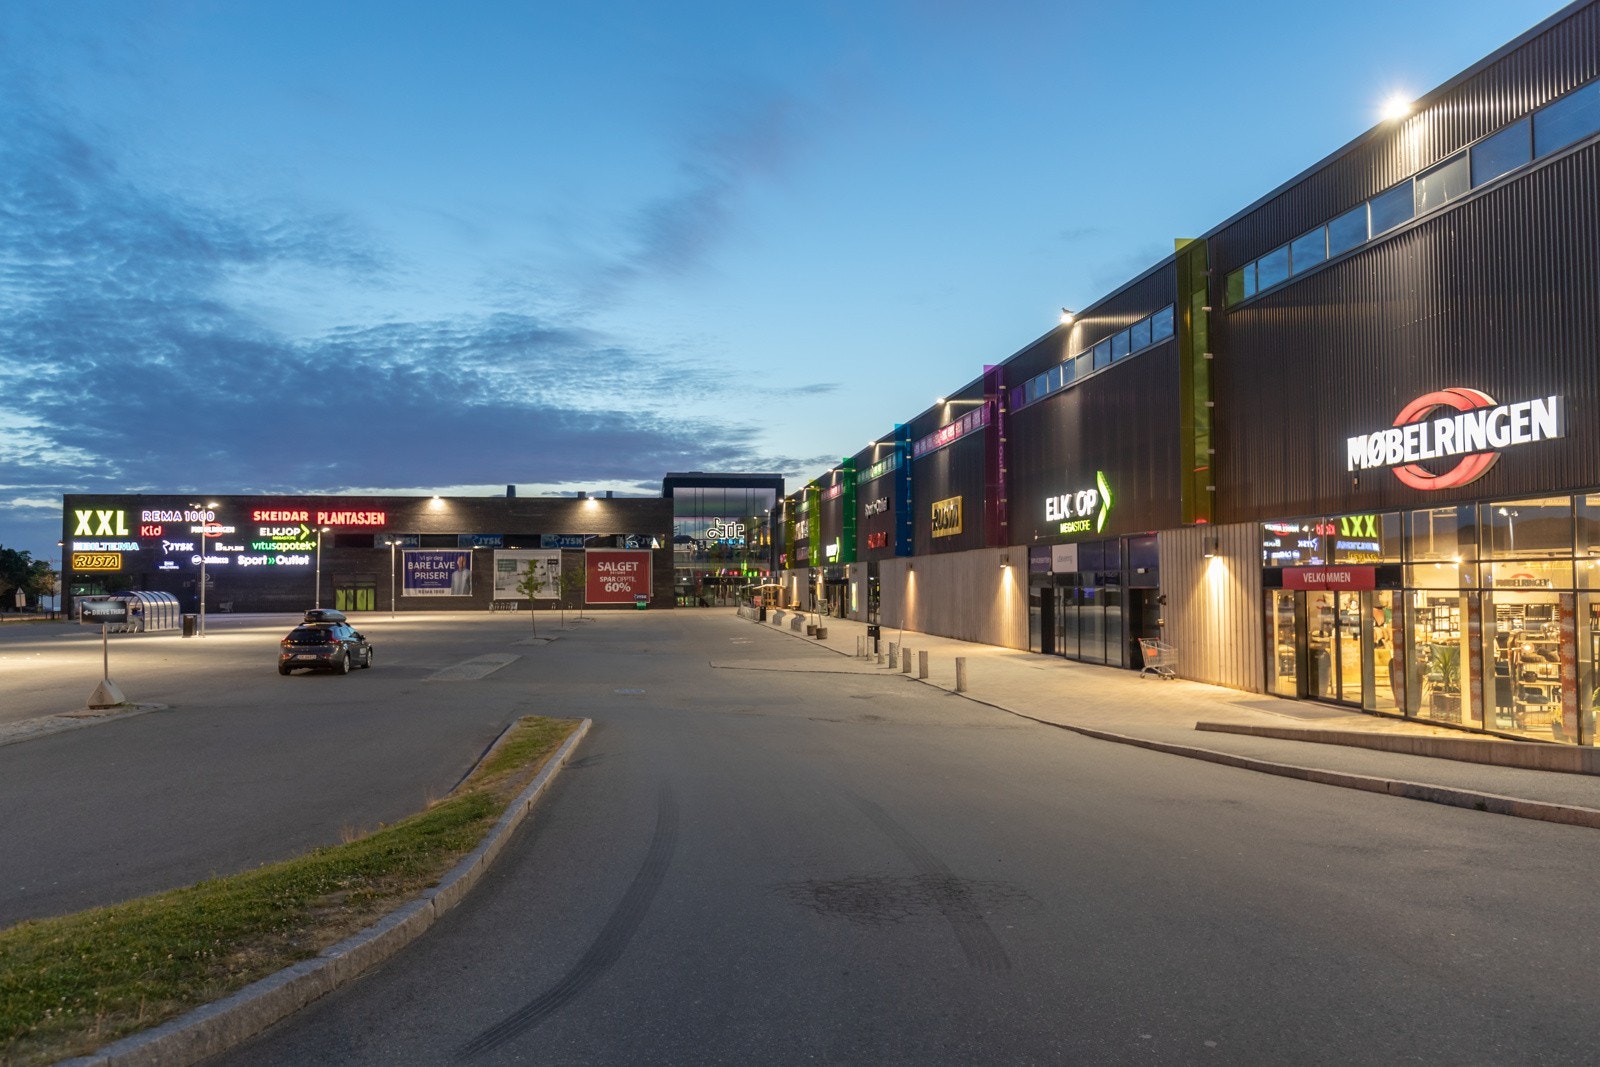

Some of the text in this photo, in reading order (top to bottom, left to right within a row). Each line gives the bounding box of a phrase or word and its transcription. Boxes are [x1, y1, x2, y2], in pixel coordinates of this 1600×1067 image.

[1347, 395, 1558, 471] MØBELRINGEN
[142, 510, 215, 521] REMA 1000
[253, 511, 309, 521] SKEIDAR
[317, 512, 385, 524] PLANTASJEN
[74, 510, 129, 536] XXL
[1060, 519, 1091, 533] MEGASTORE
[141, 526, 162, 536] Kid
[560, 537, 583, 545] JYSK
[169, 543, 194, 551] JYSK
[75, 556, 118, 567] RUSTA
[408, 561, 455, 570] BARE LAVE
[597, 561, 639, 572] SALGET
[414, 571, 448, 580] PRISER!
[1303, 572, 1351, 583] VELKOMMEN
[604, 582, 631, 593] 60%
